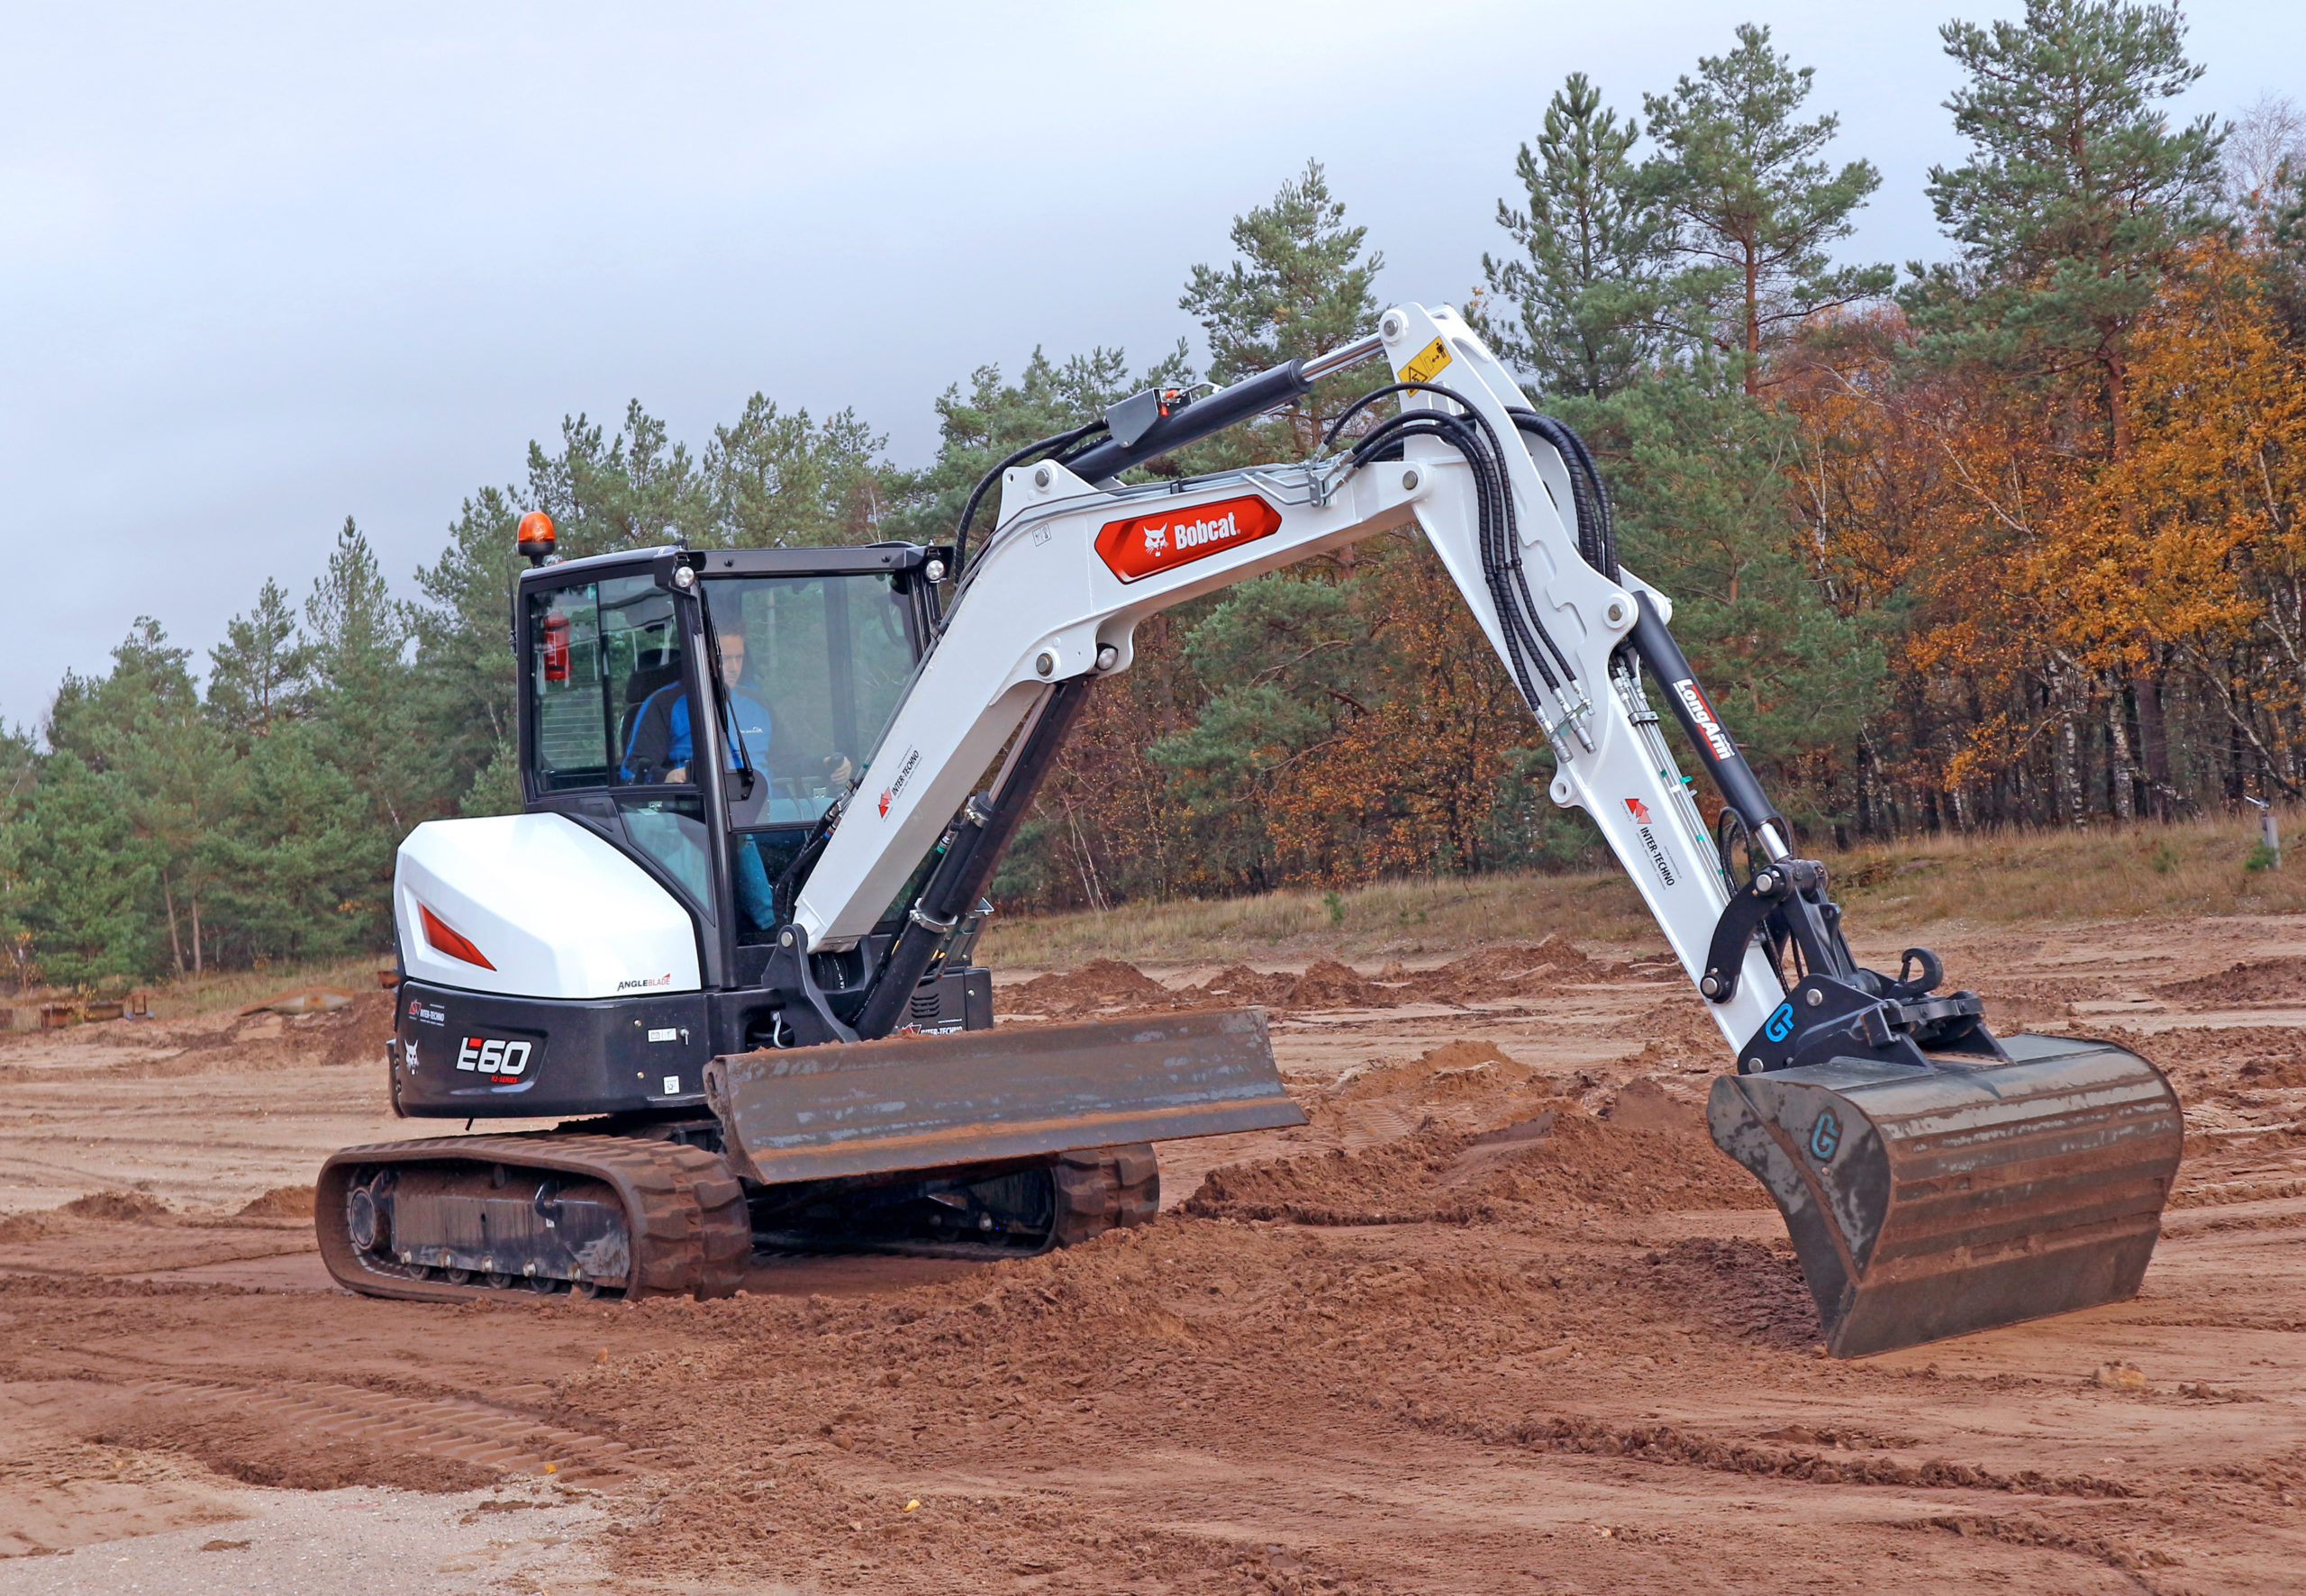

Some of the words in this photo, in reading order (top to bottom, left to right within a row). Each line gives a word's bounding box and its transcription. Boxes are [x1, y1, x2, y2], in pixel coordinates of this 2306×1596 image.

[1174, 512, 1238, 550] Bobcat
[1673, 678, 1731, 759] LongArm
[892, 749, 920, 797] INTER-TECHNO
[1639, 827, 1675, 886] INTER-TECHNO
[456, 1037, 532, 1075] E60
